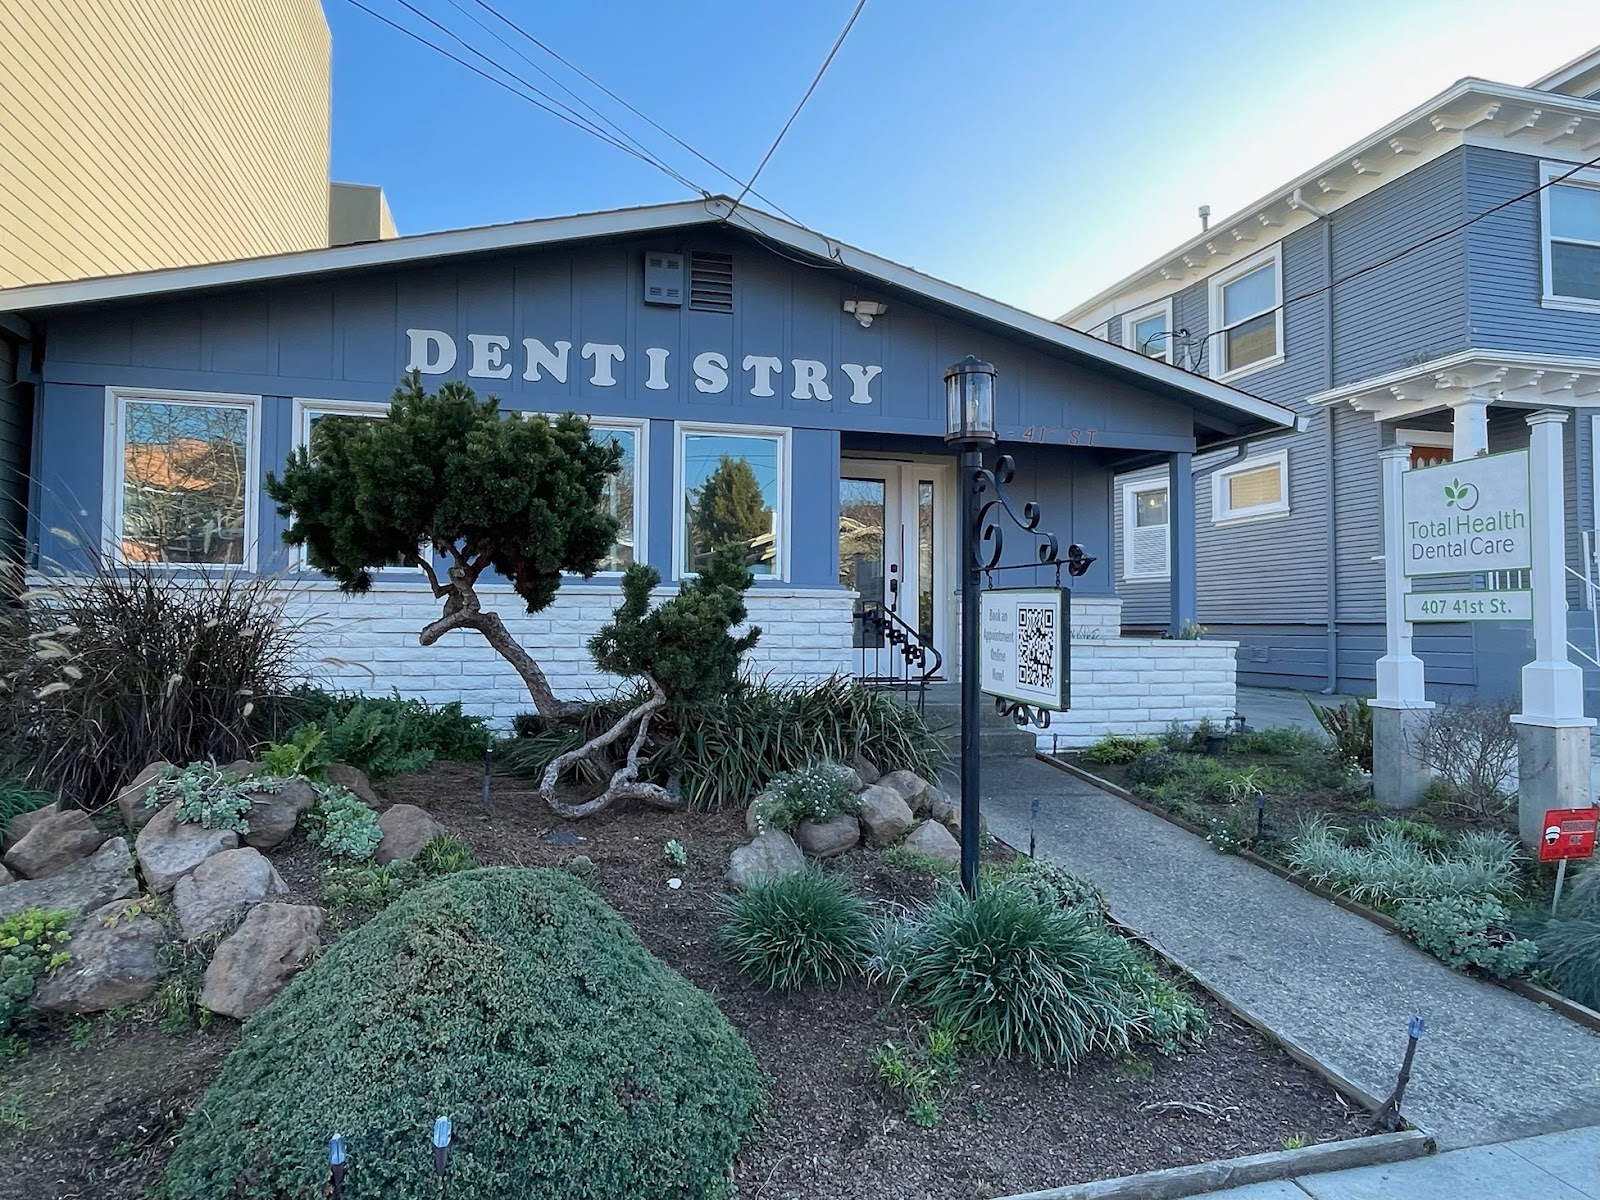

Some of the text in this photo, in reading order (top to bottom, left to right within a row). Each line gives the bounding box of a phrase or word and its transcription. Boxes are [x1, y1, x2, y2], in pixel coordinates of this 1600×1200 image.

[405, 328, 883, 404] DENTISTRY
[1069, 429, 1097, 446] ST
[1408, 508, 1525, 539] Total Health
[1412, 536, 1514, 560] Dental Care
[1421, 598, 1512, 614] 407 41st St.
